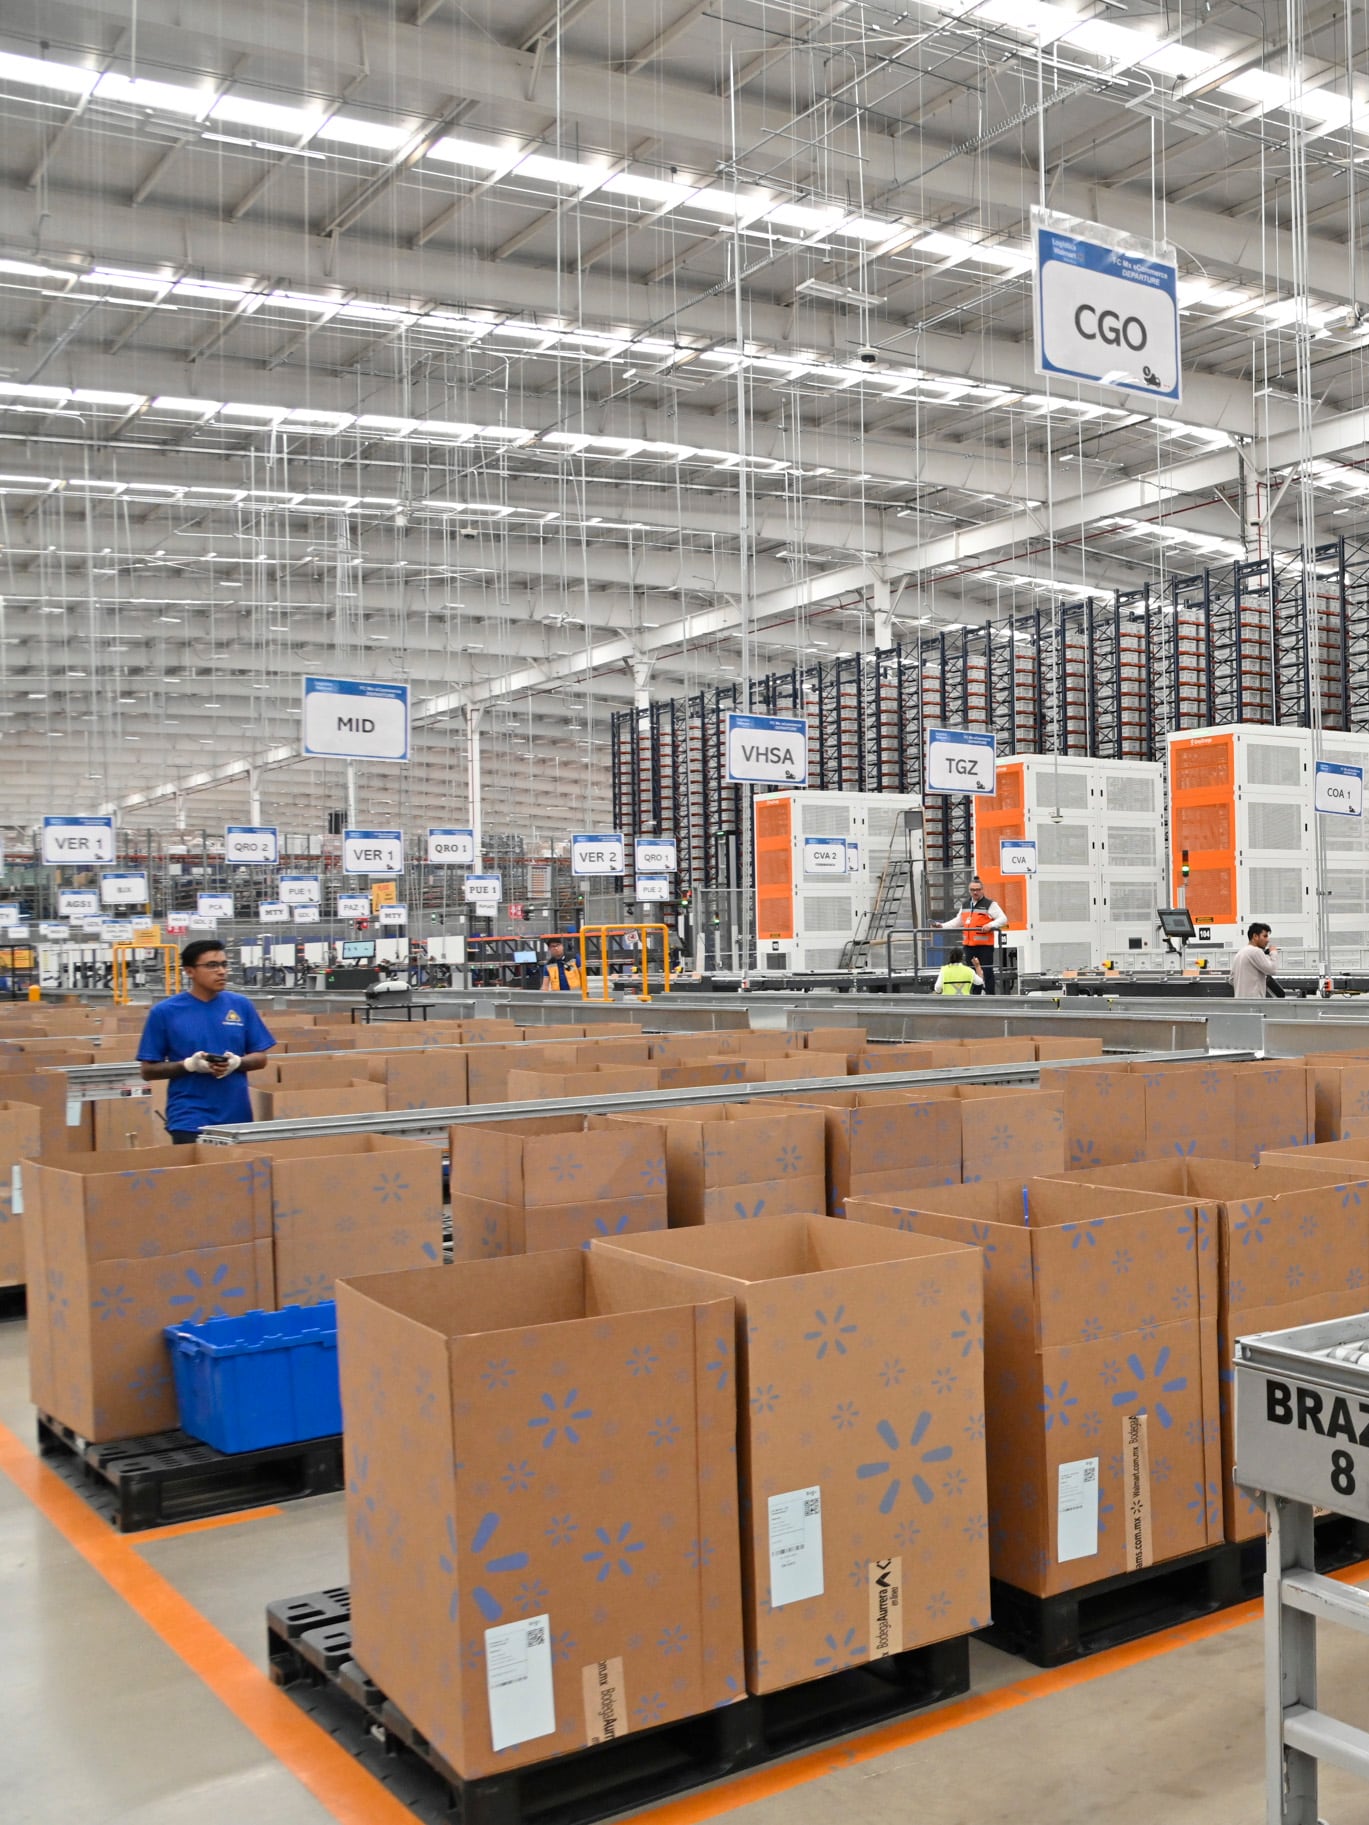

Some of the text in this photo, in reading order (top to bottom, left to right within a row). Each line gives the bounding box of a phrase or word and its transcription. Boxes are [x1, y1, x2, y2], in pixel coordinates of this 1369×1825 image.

[1122, 270, 1160, 286] DEPARTURE
[1074, 304, 1148, 352] CGO
[337, 716, 375, 733] MID
[742, 745, 794, 765] VHSA
[946, 758, 978, 776] TGZ
[1327, 787, 1351, 800] COA 1
[55, 838, 103, 850] VER 1
[234, 842, 269, 852] QRO 2
[435, 844, 467, 853] QRO 1
[354, 849, 393, 861] VER 1
[579, 852, 617, 863] VER 2
[644, 854, 662, 862] QRO
[813, 851, 837, 859] CVA 2
[1012, 856, 1027, 864] CVA
[469, 886, 496, 894] PUE 1
[1199, 930, 1210, 938] 104
[1132, 1447, 1140, 1499] Walmart.com.mx
[1330, 1449, 1355, 1495] 8
[876, 1588, 891, 1650] BodegaAurrera
